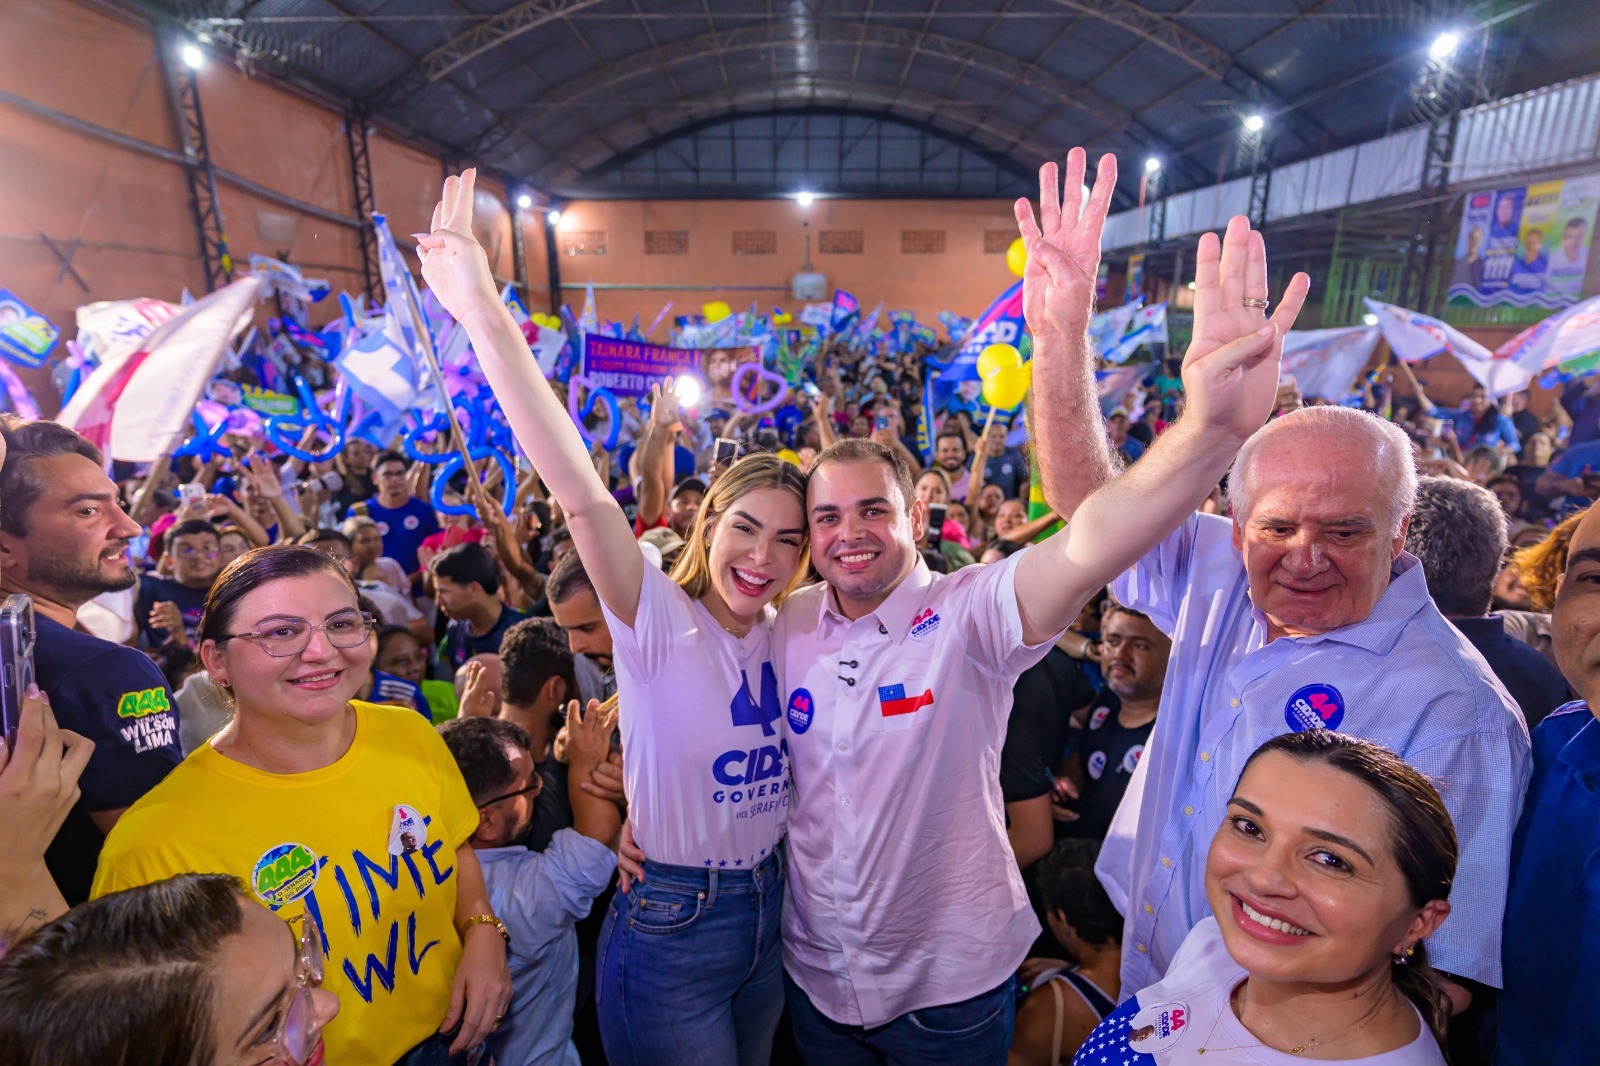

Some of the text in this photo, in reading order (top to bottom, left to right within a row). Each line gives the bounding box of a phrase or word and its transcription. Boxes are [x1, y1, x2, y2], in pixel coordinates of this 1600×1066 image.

[588, 370, 644, 391] ROBERTO
[912, 608, 934, 626] 44
[912, 614, 940, 634] CIDADE
[118, 687, 170, 718] 444
[793, 695, 810, 713] 44
[1295, 698, 1326, 729] CIDADE
[1309, 693, 1337, 719] 44
[120, 716, 175, 741] WILSON
[135, 712, 167, 725] SENADOR
[134, 730, 173, 753] LIMA
[712, 738, 790, 786] CIDA
[713, 777, 789, 803] GOVERN
[736, 810, 749, 819] VICE
[750, 797, 781, 818] SERAFI
[258, 845, 314, 894] 444
[284, 871, 311, 892] SENADOR
[285, 878, 312, 900] DO POVO
[1161, 1011, 1170, 1038] CIDADE
[1170, 1009, 1185, 1031] 44
